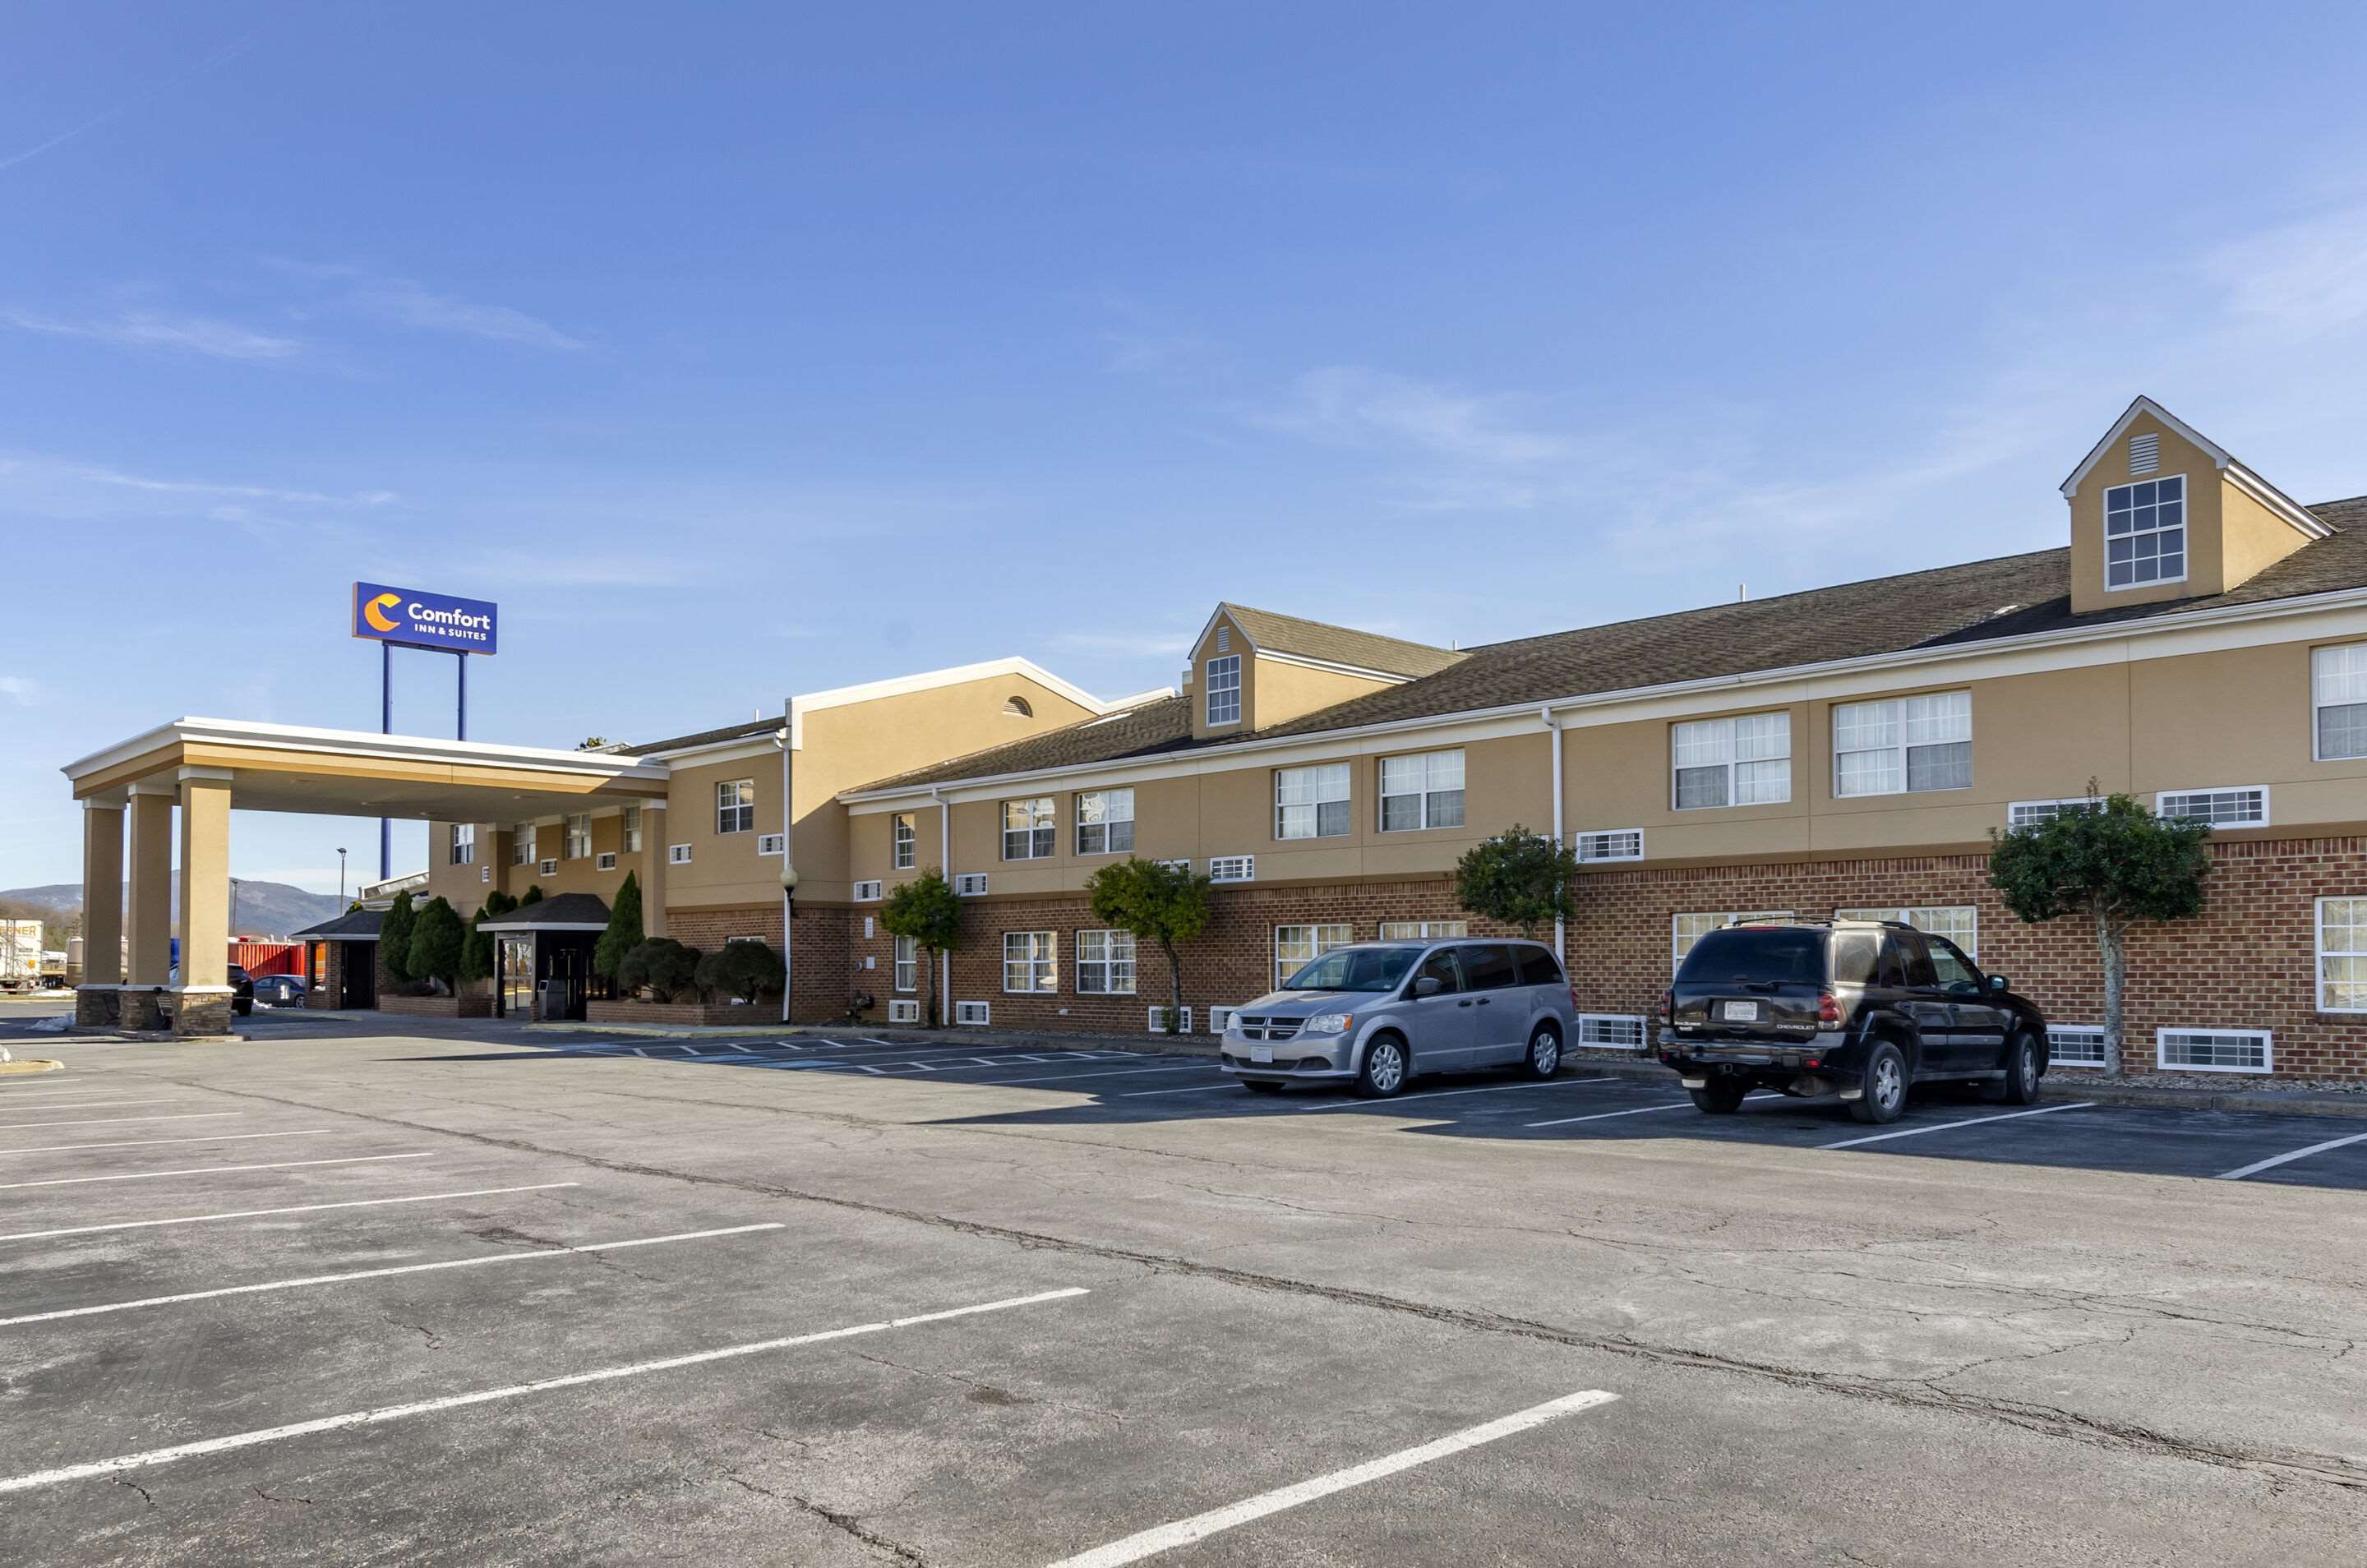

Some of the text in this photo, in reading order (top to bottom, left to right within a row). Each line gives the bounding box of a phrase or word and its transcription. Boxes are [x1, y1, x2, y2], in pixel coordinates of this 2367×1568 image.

[408, 602, 491, 630] Comfort
[414, 624, 487, 641] INN & SUITES
